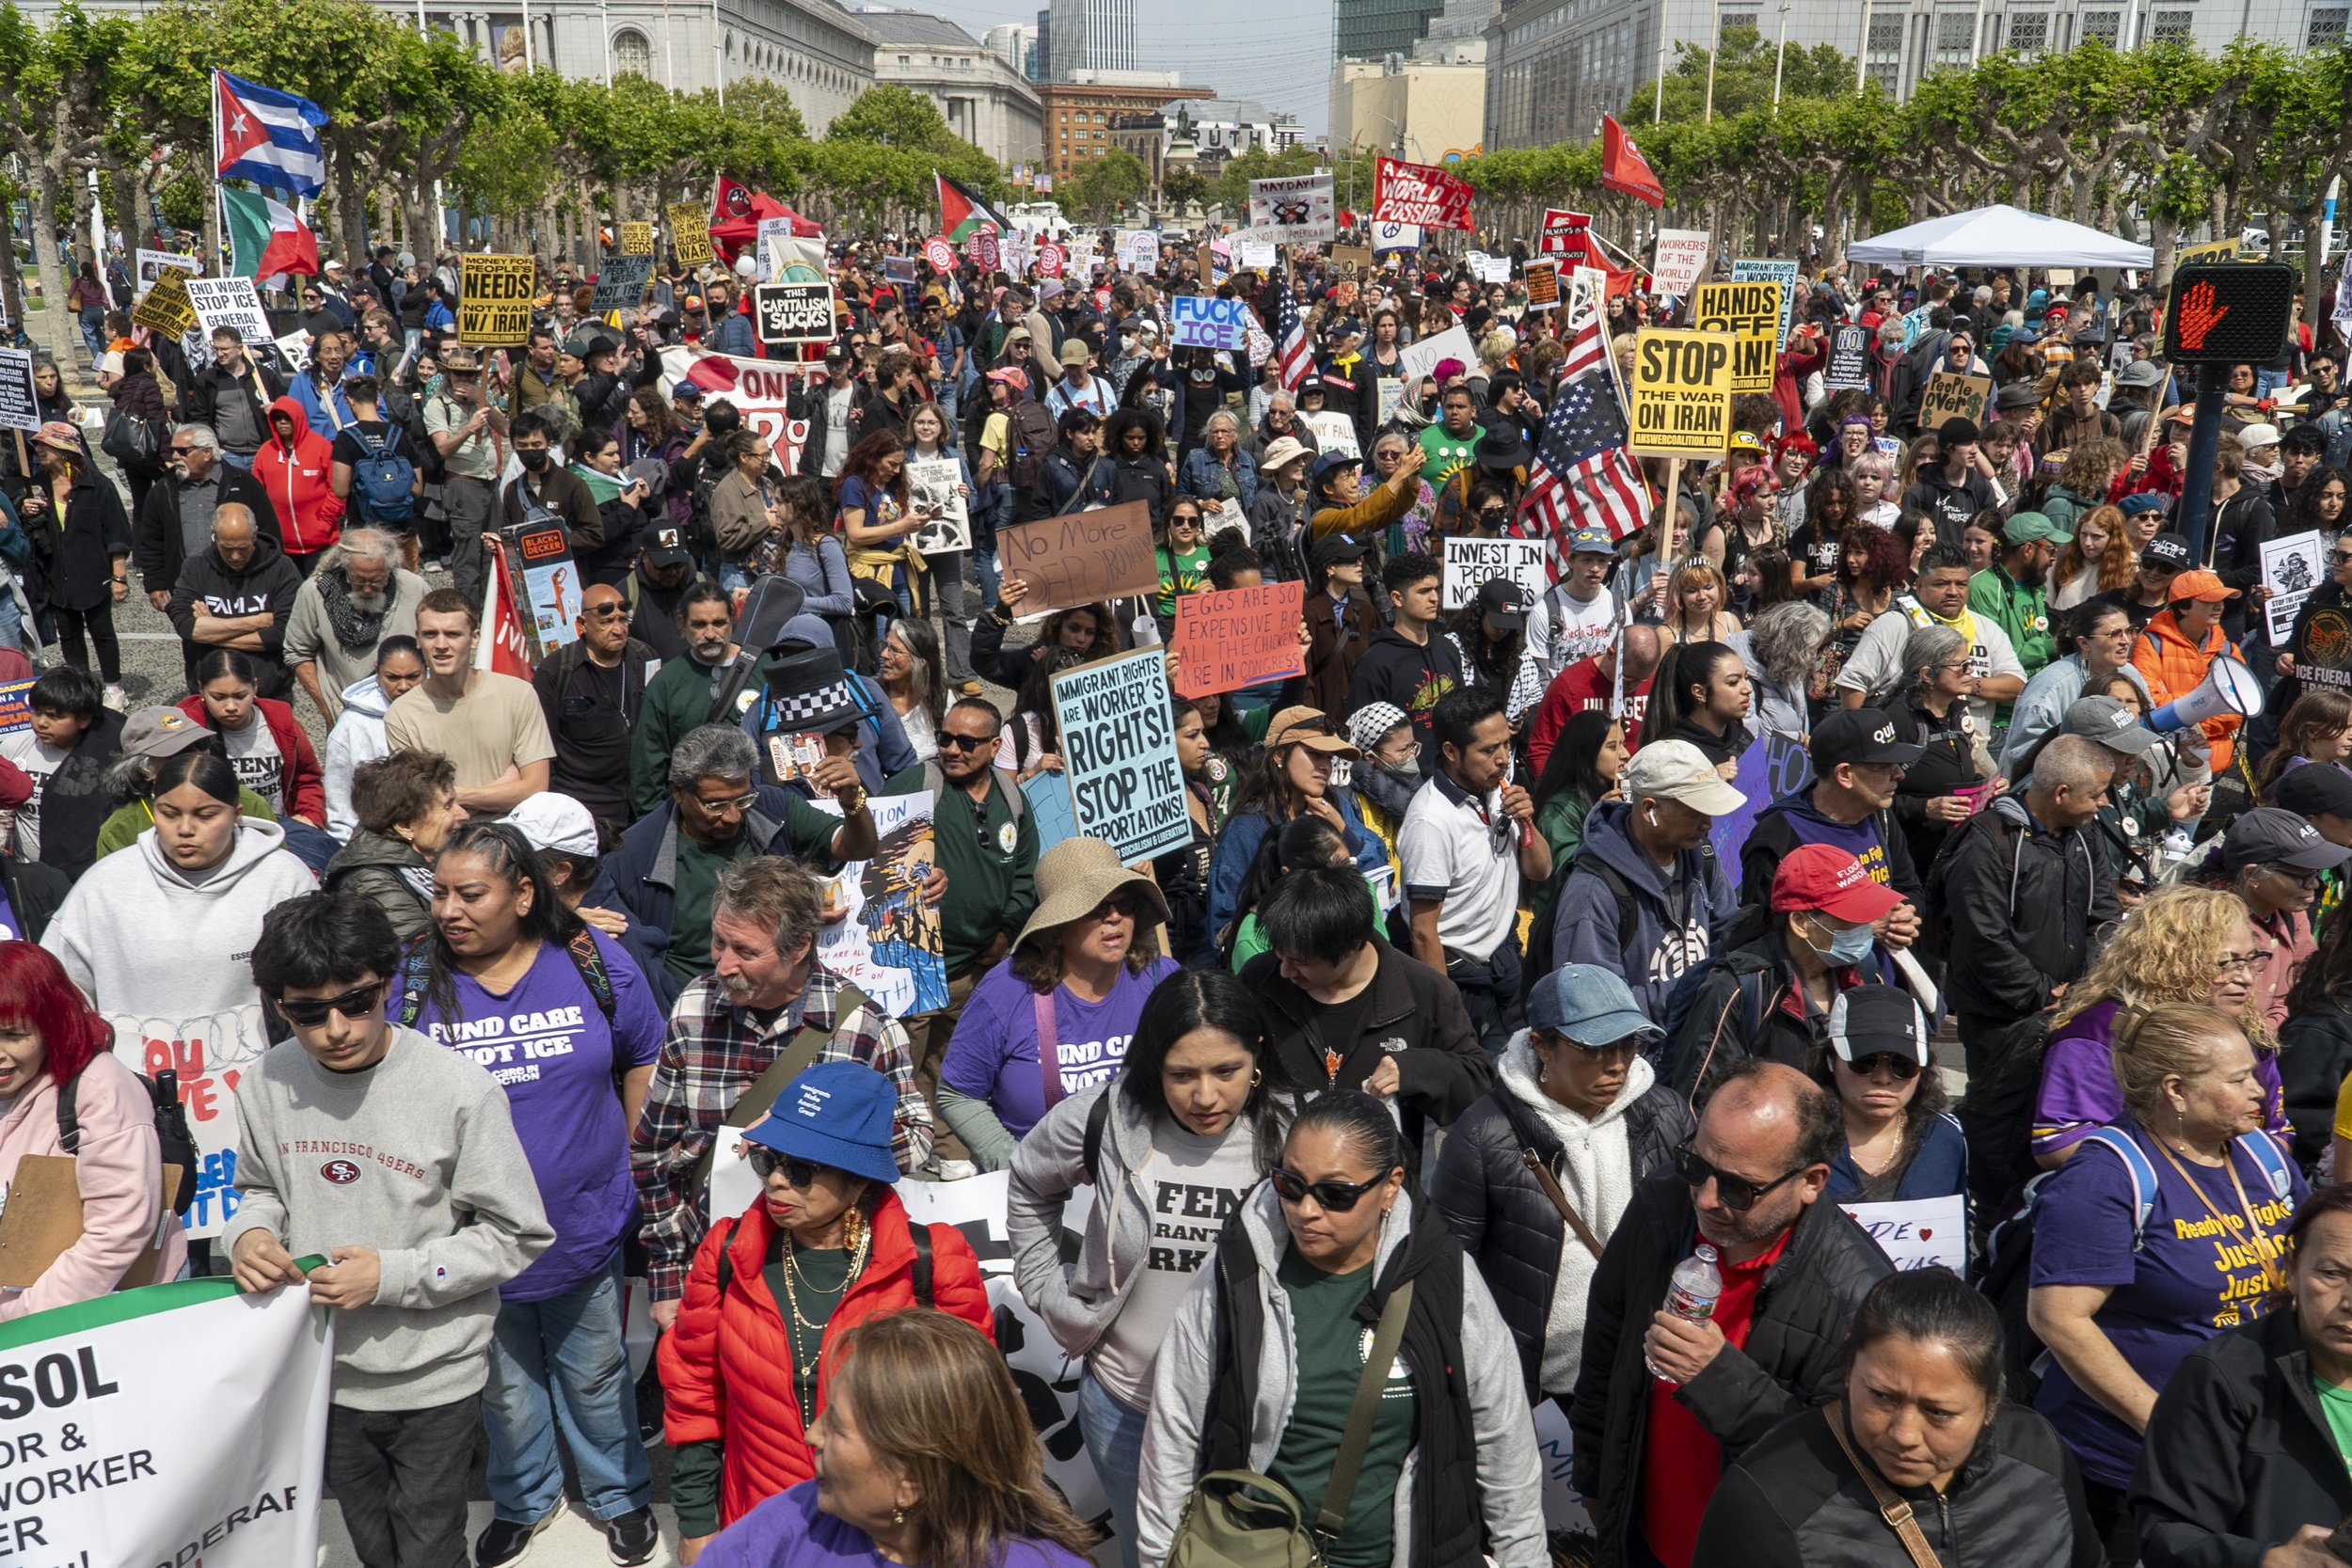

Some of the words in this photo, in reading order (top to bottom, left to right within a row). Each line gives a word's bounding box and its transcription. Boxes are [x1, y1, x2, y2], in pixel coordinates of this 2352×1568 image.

[1383, 161, 1394, 177] A
[1396, 164, 1463, 191] BETTER
[1382, 178, 1444, 203] WORLD
[1447, 190, 1467, 208] IS
[1375, 198, 1461, 229] POSSIBLE
[675, 225, 685, 234] US
[687, 221, 706, 231] INTO
[1544, 227, 1574, 235] ALWAYS
[677, 235, 707, 246] GLOBAL
[1256, 230, 1274, 243] NOT
[623, 242, 652, 254] NEEDS
[678, 245, 711, 261] WAR!
[1659, 239, 1707, 251] WORKERS
[603, 258, 633, 267] MONEY
[635, 255, 652, 263] FOR
[1541, 250, 1584, 260] ANTIFASCIST
[1661, 253, 1673, 262] OF
[1677, 253, 1696, 264] THE
[466, 264, 532, 273] PEOPLE'S
[605, 264, 646, 276] PEOPLE'S
[1343, 261, 1354, 273] NO
[1656, 267, 1692, 278] WORLD
[1735, 261, 1772, 272] IMMIGRANT
[1773, 263, 1795, 273] RIGHTS
[464, 273, 531, 299] NEEDS
[610, 274, 637, 283] NEEDS
[188, 282, 213, 295] END
[215, 280, 251, 293] WARS
[596, 286, 619, 297] NOT
[623, 283, 644, 294] THE
[784, 288, 807, 298] THIS
[1342, 283, 1354, 293] NO
[146, 296, 163, 310] NOT
[165, 301, 183, 317] WAR
[194, 296, 230, 311] STOP
[235, 293, 257, 309] ICE
[464, 304, 494, 312] NOT
[761, 297, 830, 313] CAPITALISM
[1701, 286, 1775, 317] HANDS
[771, 310, 828, 329] SUCKS
[1175, 296, 1246, 327] FUCK
[136, 306, 186, 335] OCCUPATION
[206, 313, 259, 327] GENERAL
[464, 313, 488, 332] W/
[493, 313, 529, 332] IRAN
[1181, 321, 1234, 348] ICE
[1836, 329, 1866, 350] NO!
[1410, 346, 1438, 373] NO
[1641, 339, 1727, 386] STOP
[9, 391, 25, 400] Whole
[10, 398, 32, 407] Fascist
[1638, 390, 1676, 402] THE
[1680, 391, 1724, 404] WAR
[1638, 404, 1666, 430] ON
[1674, 404, 1723, 432] IRAN
[1635, 433, 1723, 448] ANSWERCOALITION.ORG
[525, 534, 559, 546] BLACK+
[527, 542, 561, 554] DECKER
[1007, 526, 1049, 566] No
[1059, 520, 1127, 551] More
[1448, 543, 1511, 565] INVEST
[1519, 545, 1543, 565] IN
[1182, 592, 1234, 618] EGGS
[1243, 587, 1270, 609] ARE
[1279, 584, 1296, 604] SO
[2270, 603, 2298, 614] IMMIGRANT
[2271, 597, 2285, 608] STOP
[2285, 595, 2295, 605] THE
[1189, 612, 1273, 640] EXPENSIVE
[1179, 643, 1206, 664] ALL
[1214, 637, 1250, 660] THE
[1254, 631, 1299, 655] CHICKENS
[1056, 667, 1121, 703] IMMIGRANT
[1123, 656, 1160, 682] RIGHTS
[1183, 665, 1212, 691] ARE
[1220, 663, 1234, 684] IN
[1240, 652, 1300, 680] CONGRESS
[2296, 664, 2313, 680] ICE
[2314, 667, 2351, 687] FUERA
[1063, 706, 1081, 724] ARE
[1081, 676, 1165, 722] WORKER'S
[2191, 696, 2206, 708] PYLE
[1067, 703, 1170, 776] RIGHTS!
[771, 743, 786, 776] FUNDRAISE
[1076, 767, 1137, 825] STOP
[1142, 757, 1180, 800] THE
[1212, 784, 1231, 815] 14
[1158, 821, 1188, 843] LIBERATION
[1859, 852, 1868, 864] to
[230, 951, 252, 960] ESSE
[871, 970, 884, 979] ON
[429, 1016, 505, 1043] FUND
[509, 1006, 584, 1035] CARE
[522, 1036, 574, 1059] ICE
[525, 1065, 539, 1073] IN
[800, 1084, 831, 1099] Immigrants
[803, 1092, 821, 1103] Make
[798, 1107, 816, 1117] Great
[294, 1140, 373, 1160] FRANCISCO
[377, 1151, 425, 1180] 49ERS
[1866, 1221, 1914, 1241] DE
[2173, 1214, 2226, 1240] Ready
[2223, 1213, 2245, 1229] to
[60, 1422, 87, 1452] &
